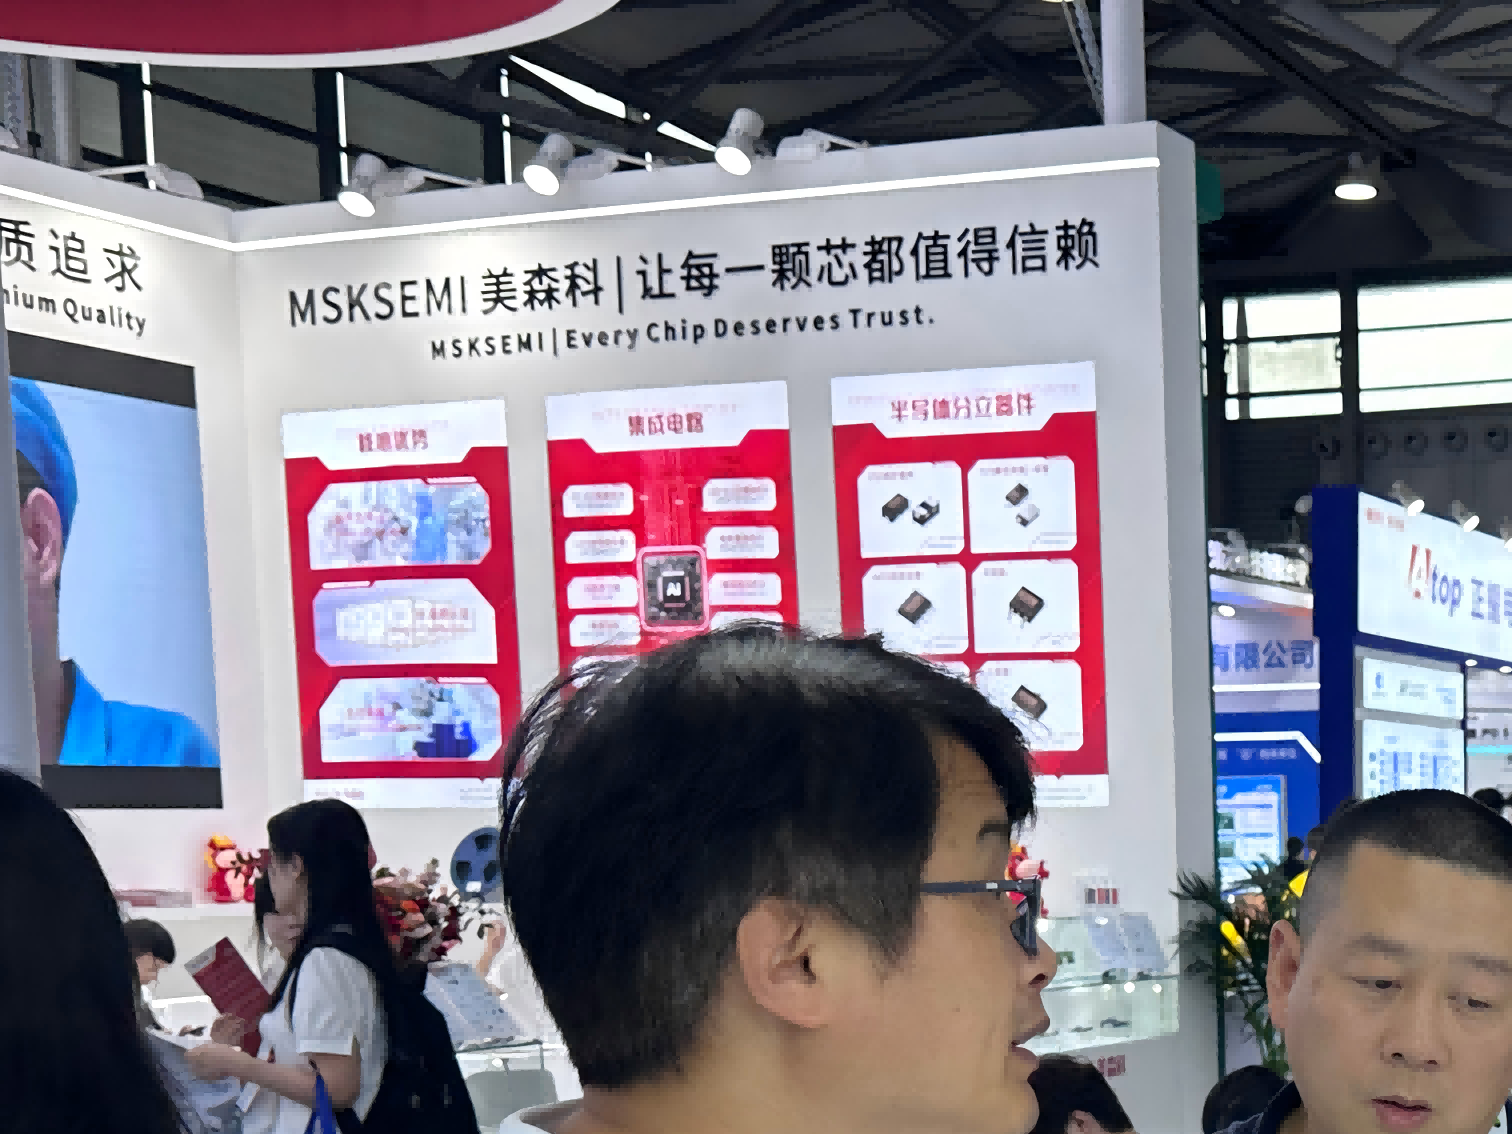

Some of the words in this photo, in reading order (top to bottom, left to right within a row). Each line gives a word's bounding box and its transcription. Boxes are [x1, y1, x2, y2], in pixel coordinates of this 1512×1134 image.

[288, 275, 468, 328] MSKSEMI
[634, 217, 1100, 301] 让每一颗芯都值得信赖
[62, 297, 147, 338] Quality
[431, 331, 545, 361] MSKSEMI
[566, 326, 639, 351] Every
[646, 317, 706, 345] Chip
[713, 308, 841, 337] Deserves
[848, 304, 935, 331] Trust.
